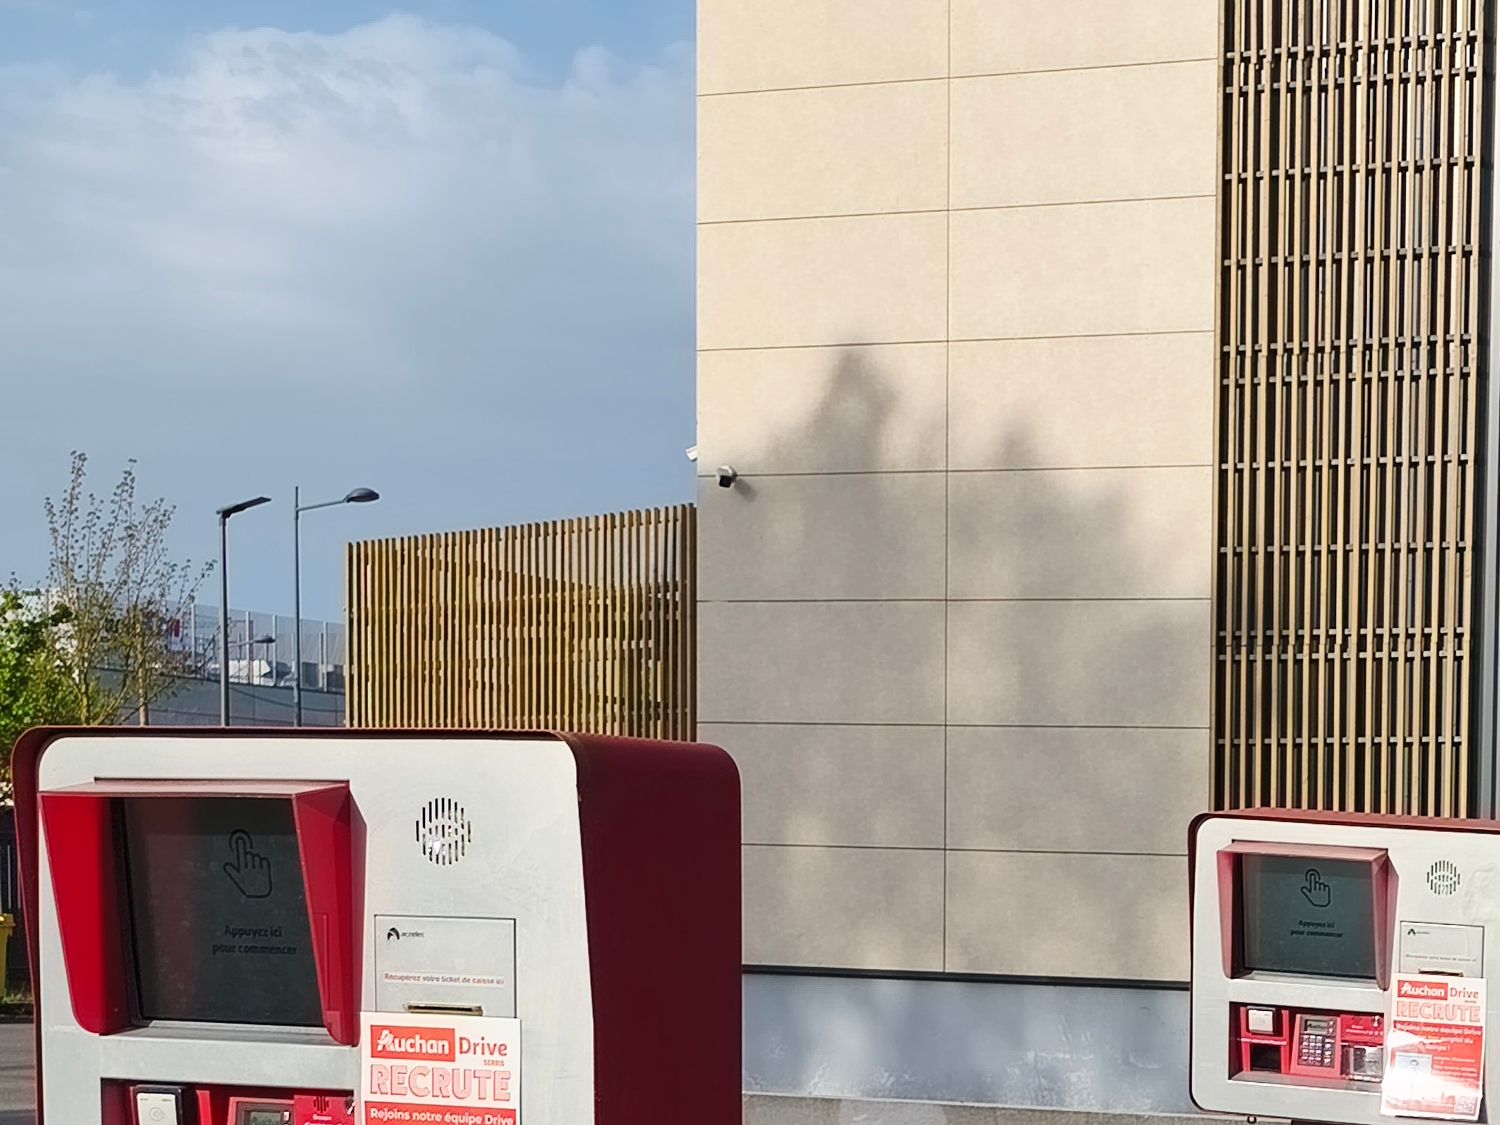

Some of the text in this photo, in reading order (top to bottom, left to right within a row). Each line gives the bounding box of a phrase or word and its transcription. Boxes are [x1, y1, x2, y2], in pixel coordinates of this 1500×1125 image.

[1401, 982, 1479, 999] Auchan Drive
[1396, 1000, 1481, 1023] RECRUTE
[376, 1029, 508, 1057] Auchan Drive
[370, 1064, 511, 1102] RECRUTE
[370, 1107, 410, 1122] Rejoins
[412, 1110, 442, 1122] notre
[444, 1111, 482, 1125] équipe
